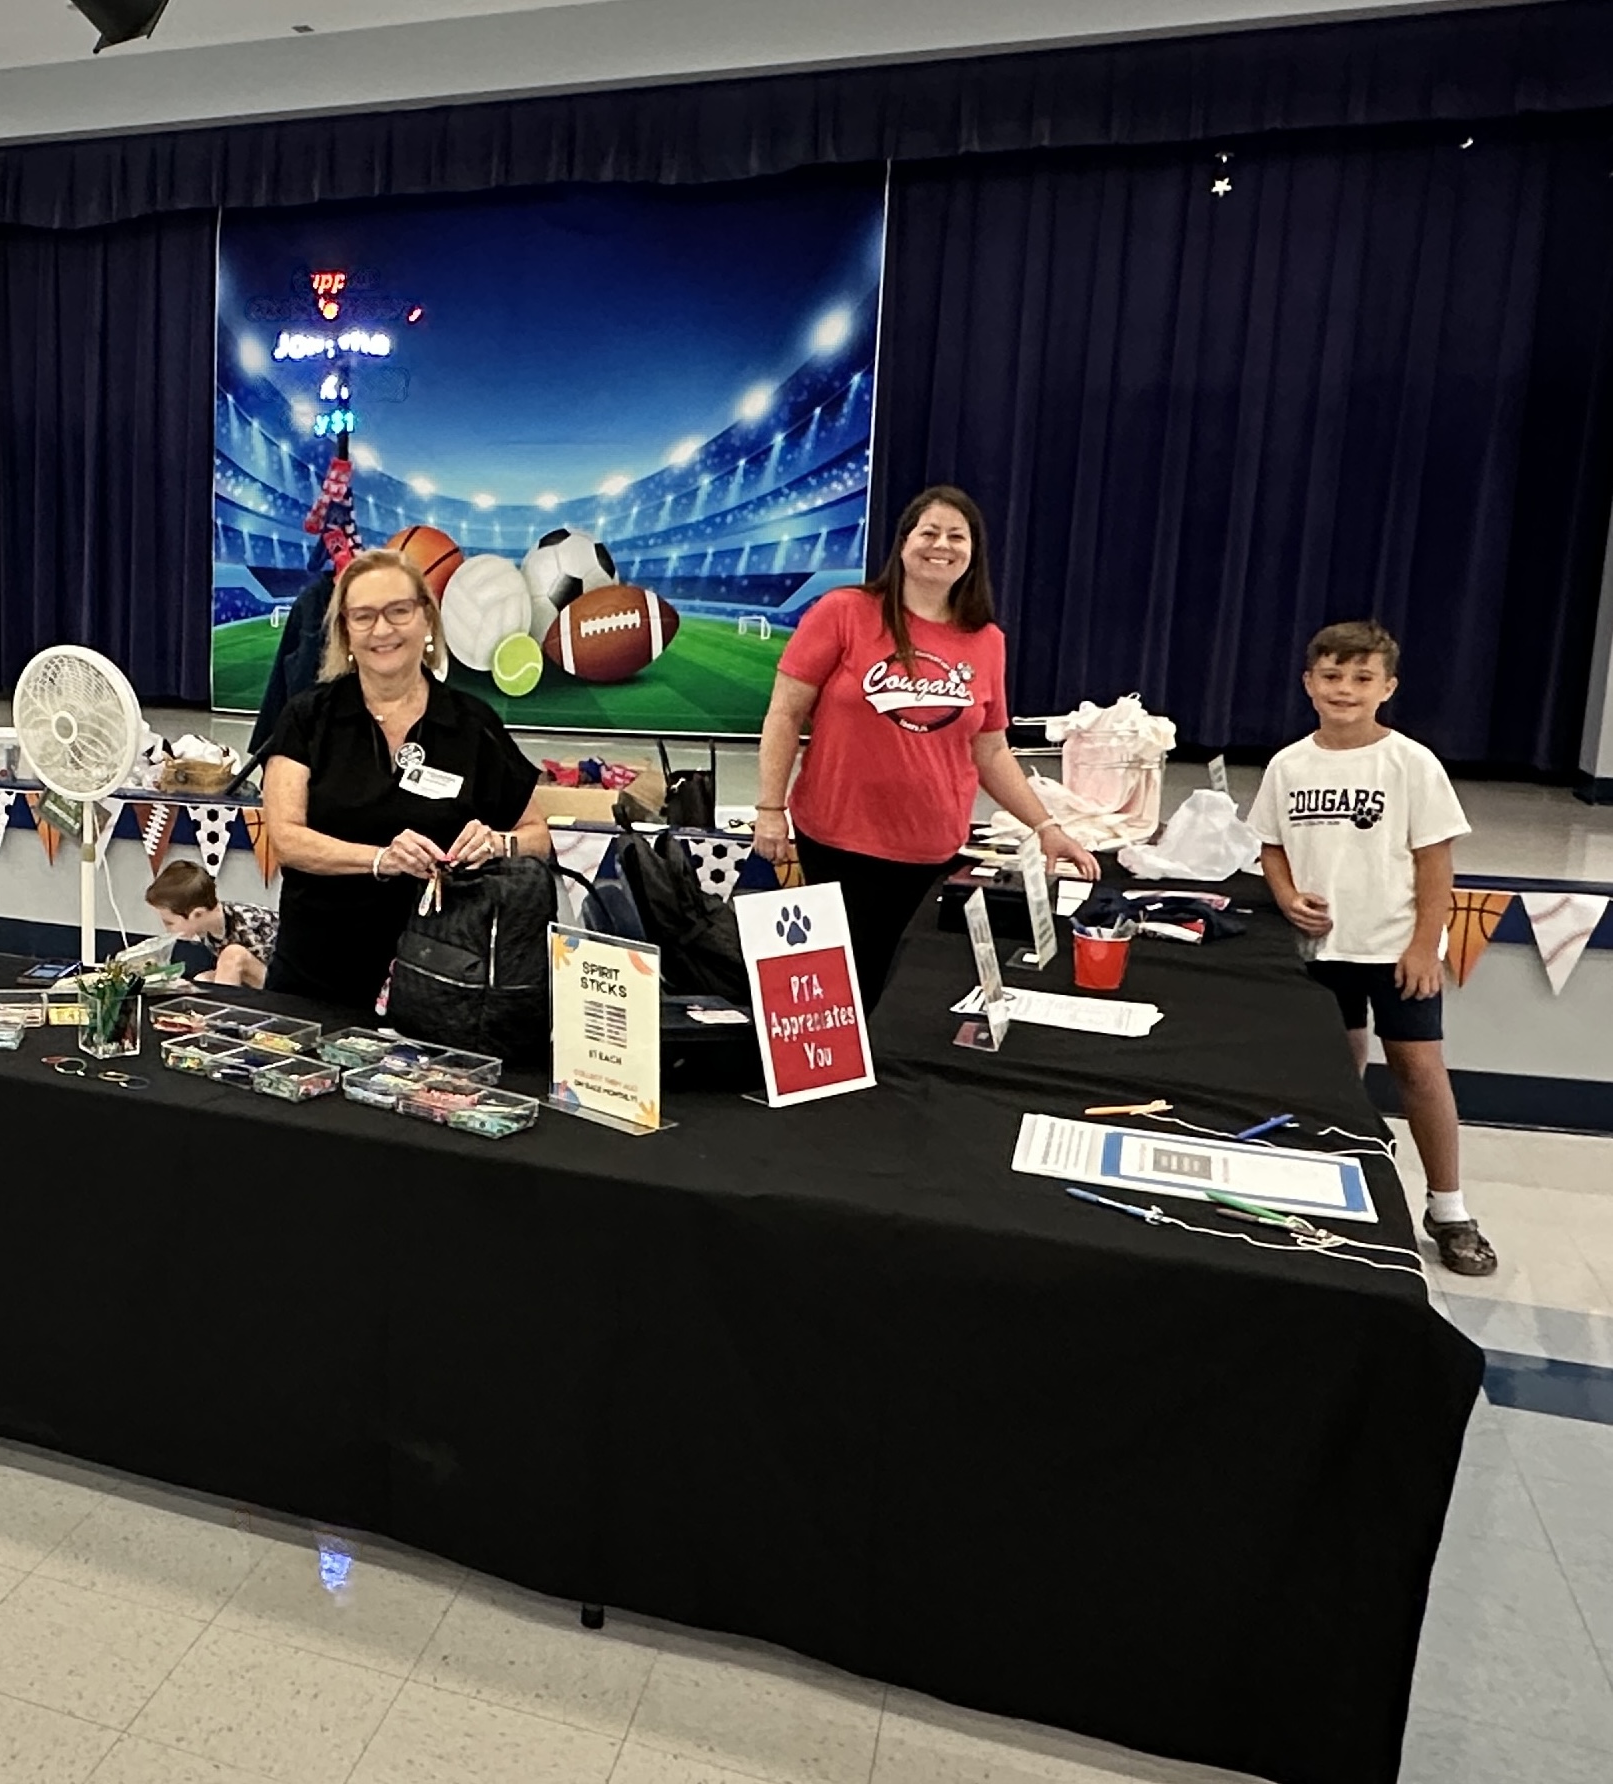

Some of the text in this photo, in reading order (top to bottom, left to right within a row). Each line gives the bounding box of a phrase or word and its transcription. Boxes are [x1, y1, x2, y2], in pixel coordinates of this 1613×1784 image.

[862, 661, 972, 701] Cougars
[582, 961, 620, 981] SPIRIT
[580, 976, 628, 998] STICKS
[790, 973, 824, 1004] PTA
[771, 1004, 855, 1042] Appreciates
[803, 1042, 833, 1070] You
